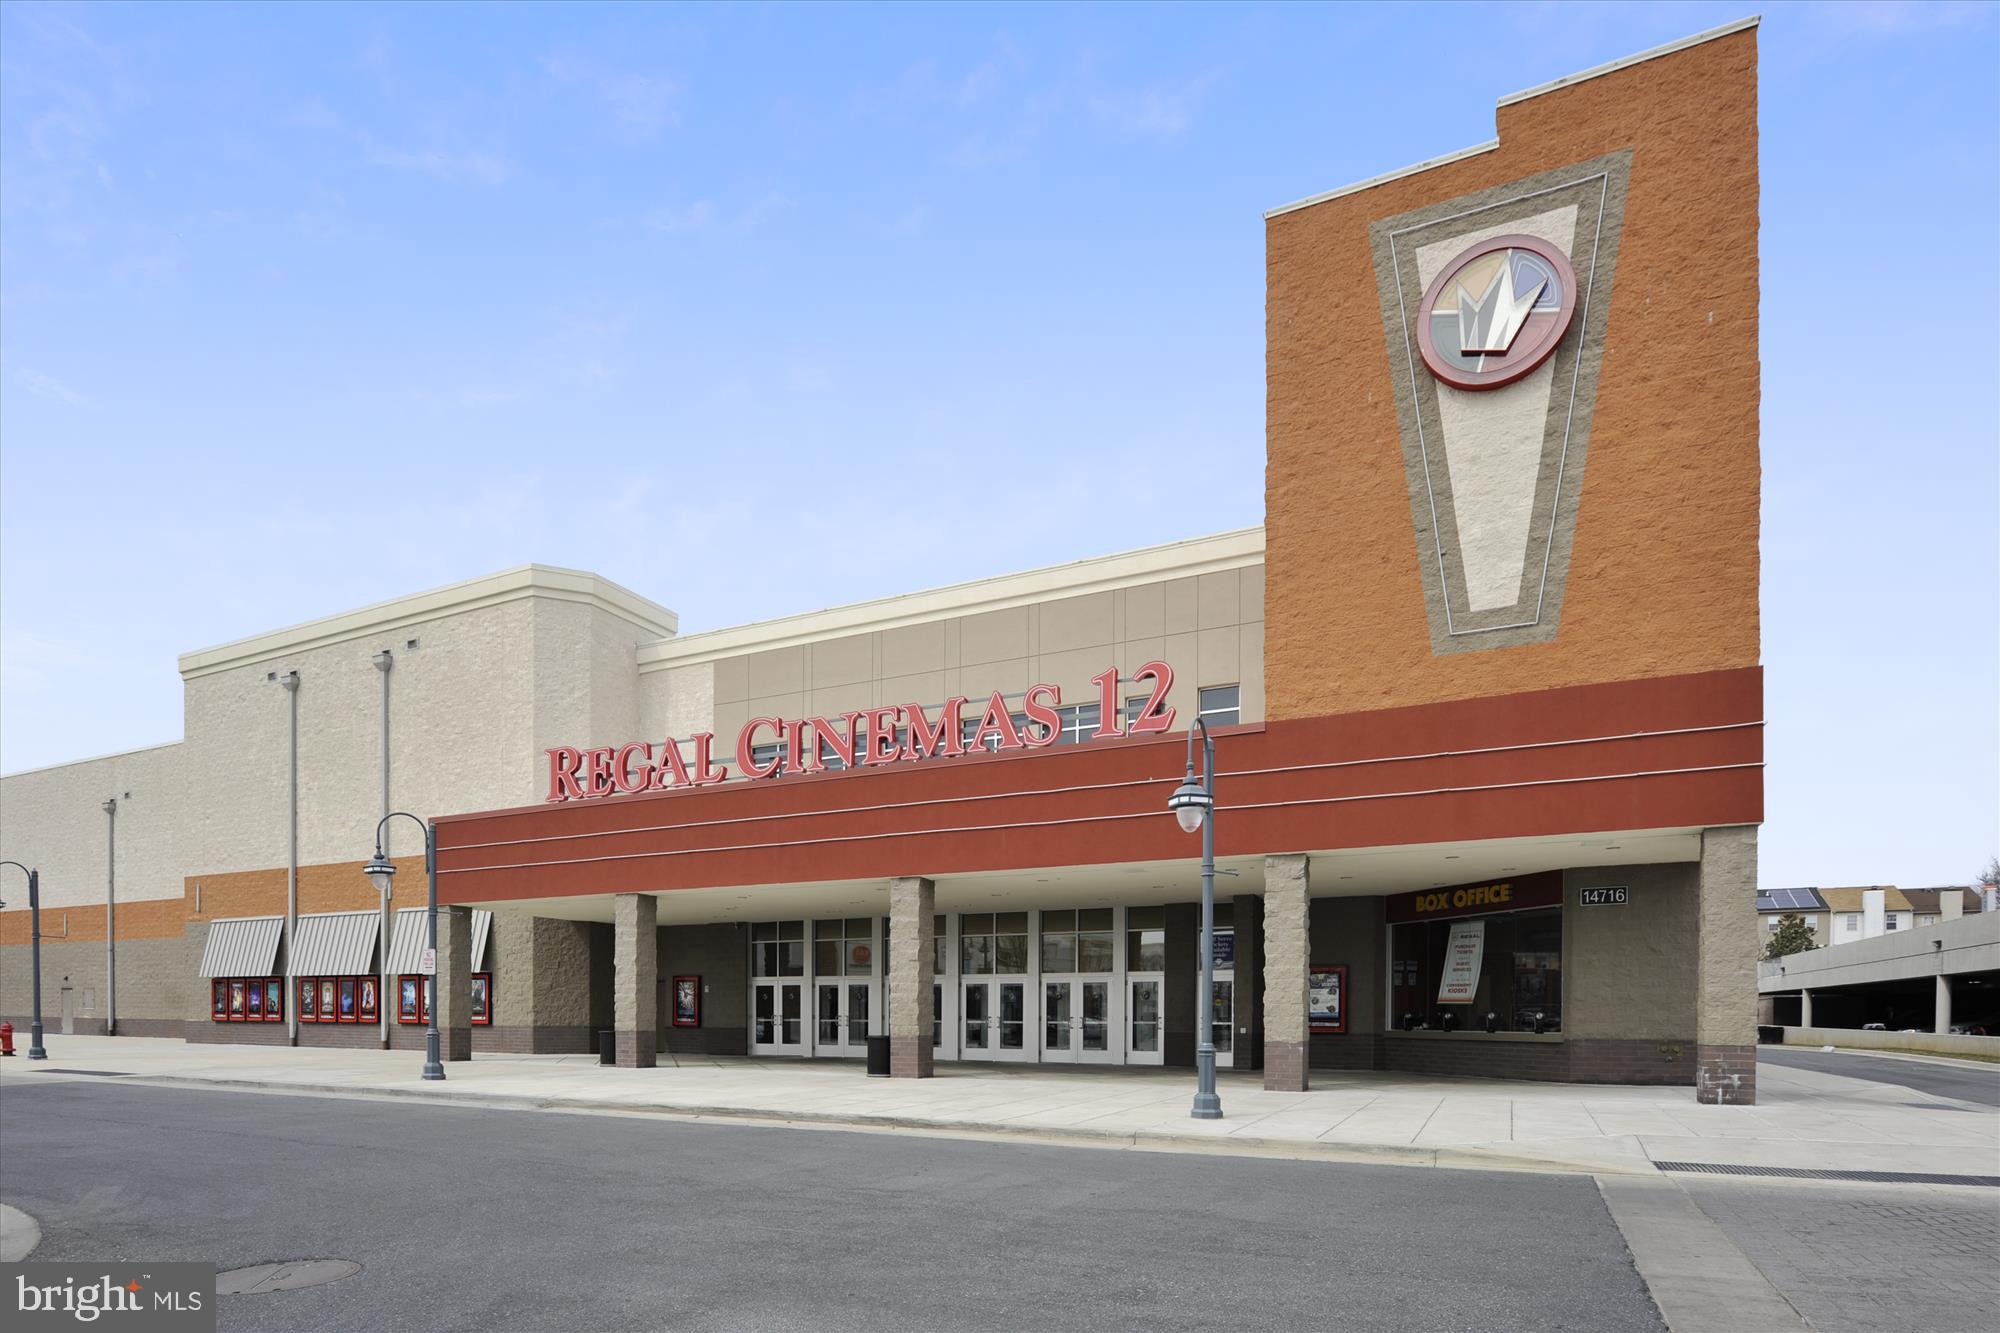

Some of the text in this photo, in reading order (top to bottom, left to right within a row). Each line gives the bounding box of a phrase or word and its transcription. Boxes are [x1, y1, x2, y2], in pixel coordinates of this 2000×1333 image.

[545, 660, 1176, 802] REGAL CINEMAS 12
[1415, 884, 1512, 912] BOX OFFICE
[1582, 889, 1625, 904] 14716
